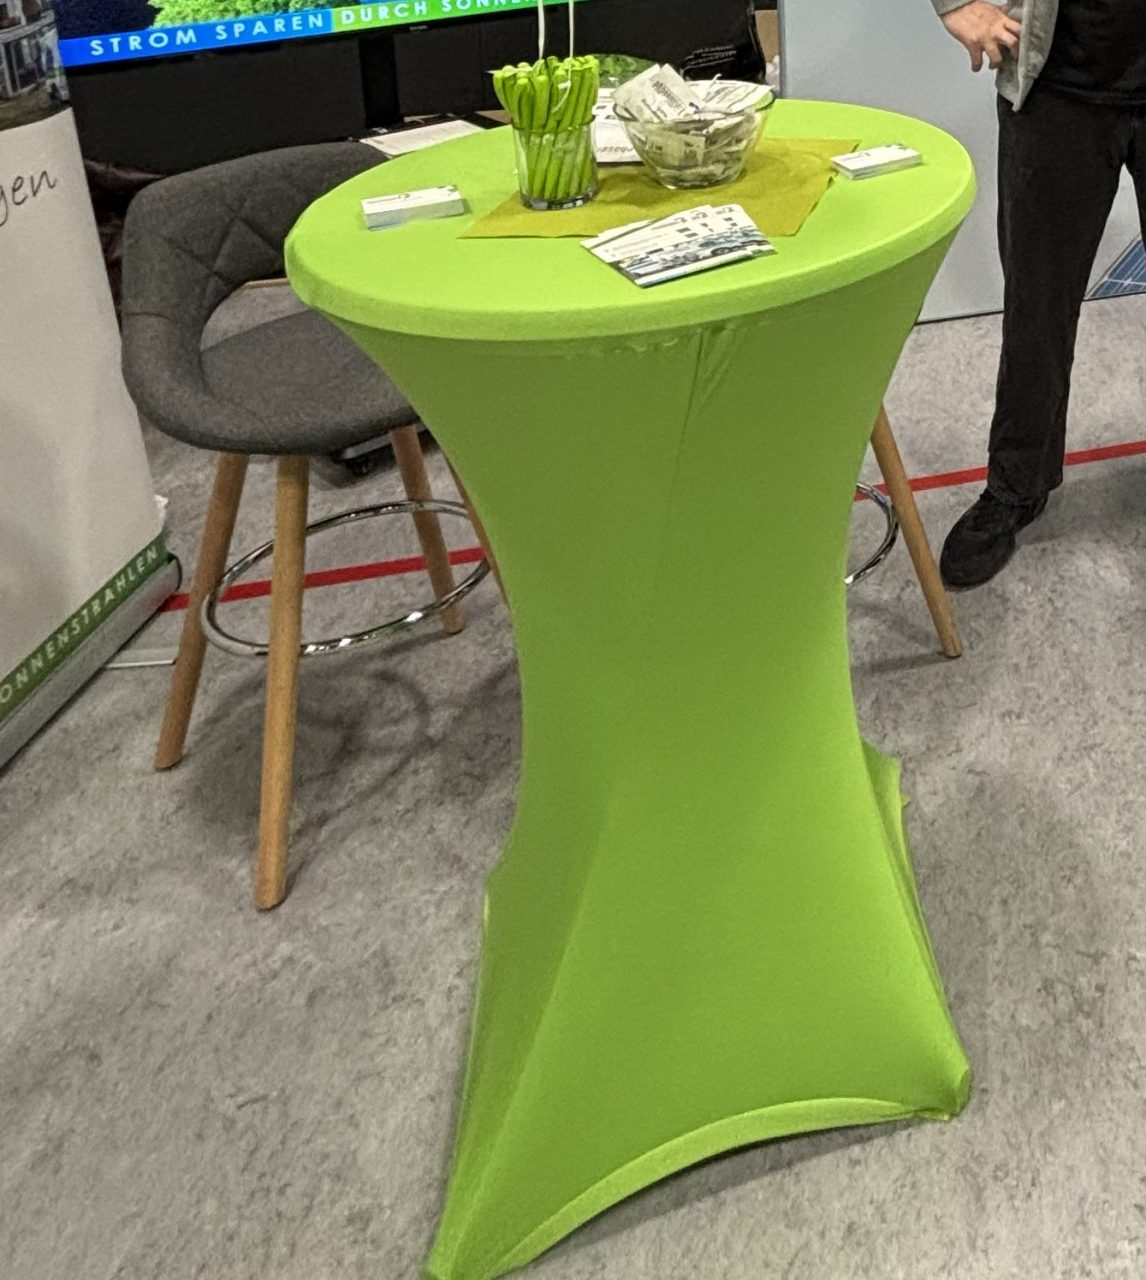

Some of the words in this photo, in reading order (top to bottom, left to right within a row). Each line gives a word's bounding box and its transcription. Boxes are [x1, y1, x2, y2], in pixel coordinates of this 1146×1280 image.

[90, 28, 197, 56] STROM
[215, 14, 324, 40] SPAREN
[341, 2, 427, 25] DURCH
